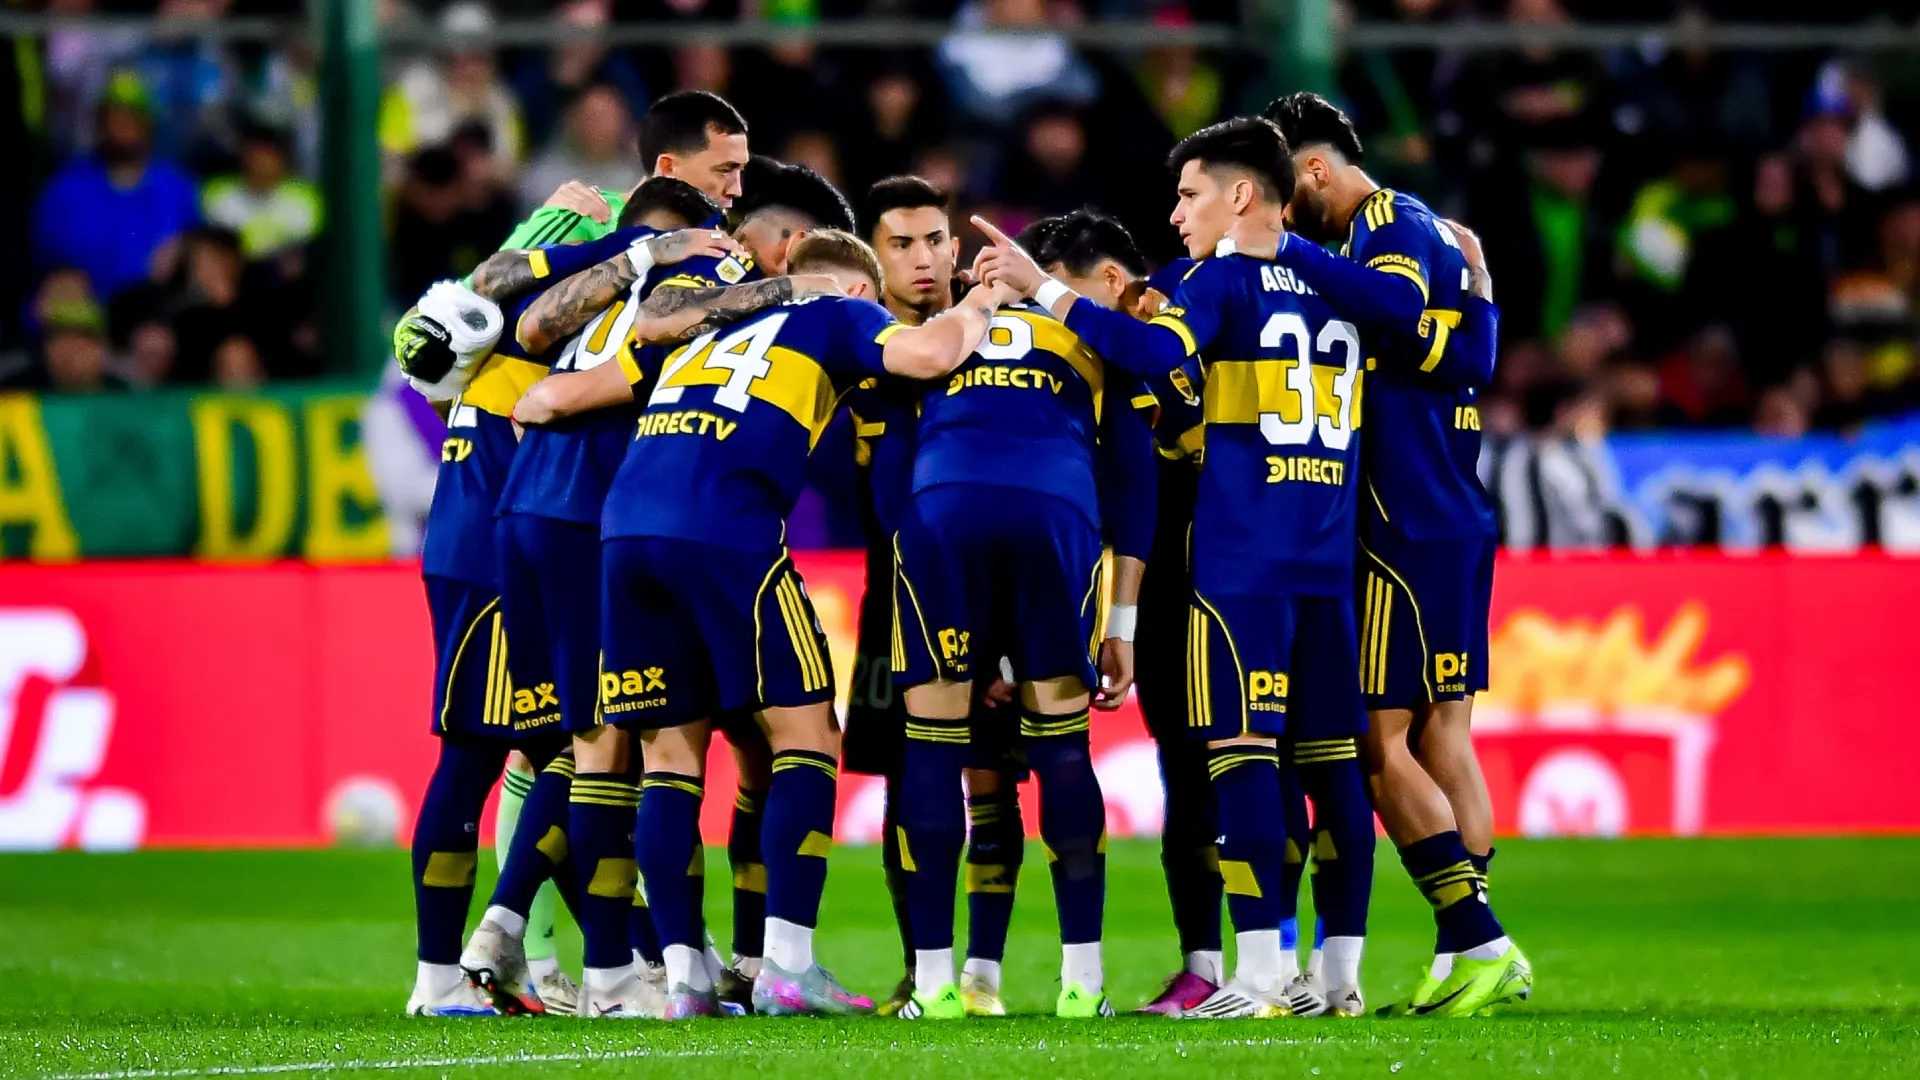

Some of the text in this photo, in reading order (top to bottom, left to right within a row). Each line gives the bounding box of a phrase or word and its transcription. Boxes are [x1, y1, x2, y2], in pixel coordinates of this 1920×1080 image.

[646, 311, 790, 414] 24
[946, 365, 1063, 397] DIRECTV
[1259, 312, 1360, 450] 33
[1265, 455, 1345, 487] DIRECT
[600, 666, 666, 705] pax
[603, 696, 667, 715] assistance
